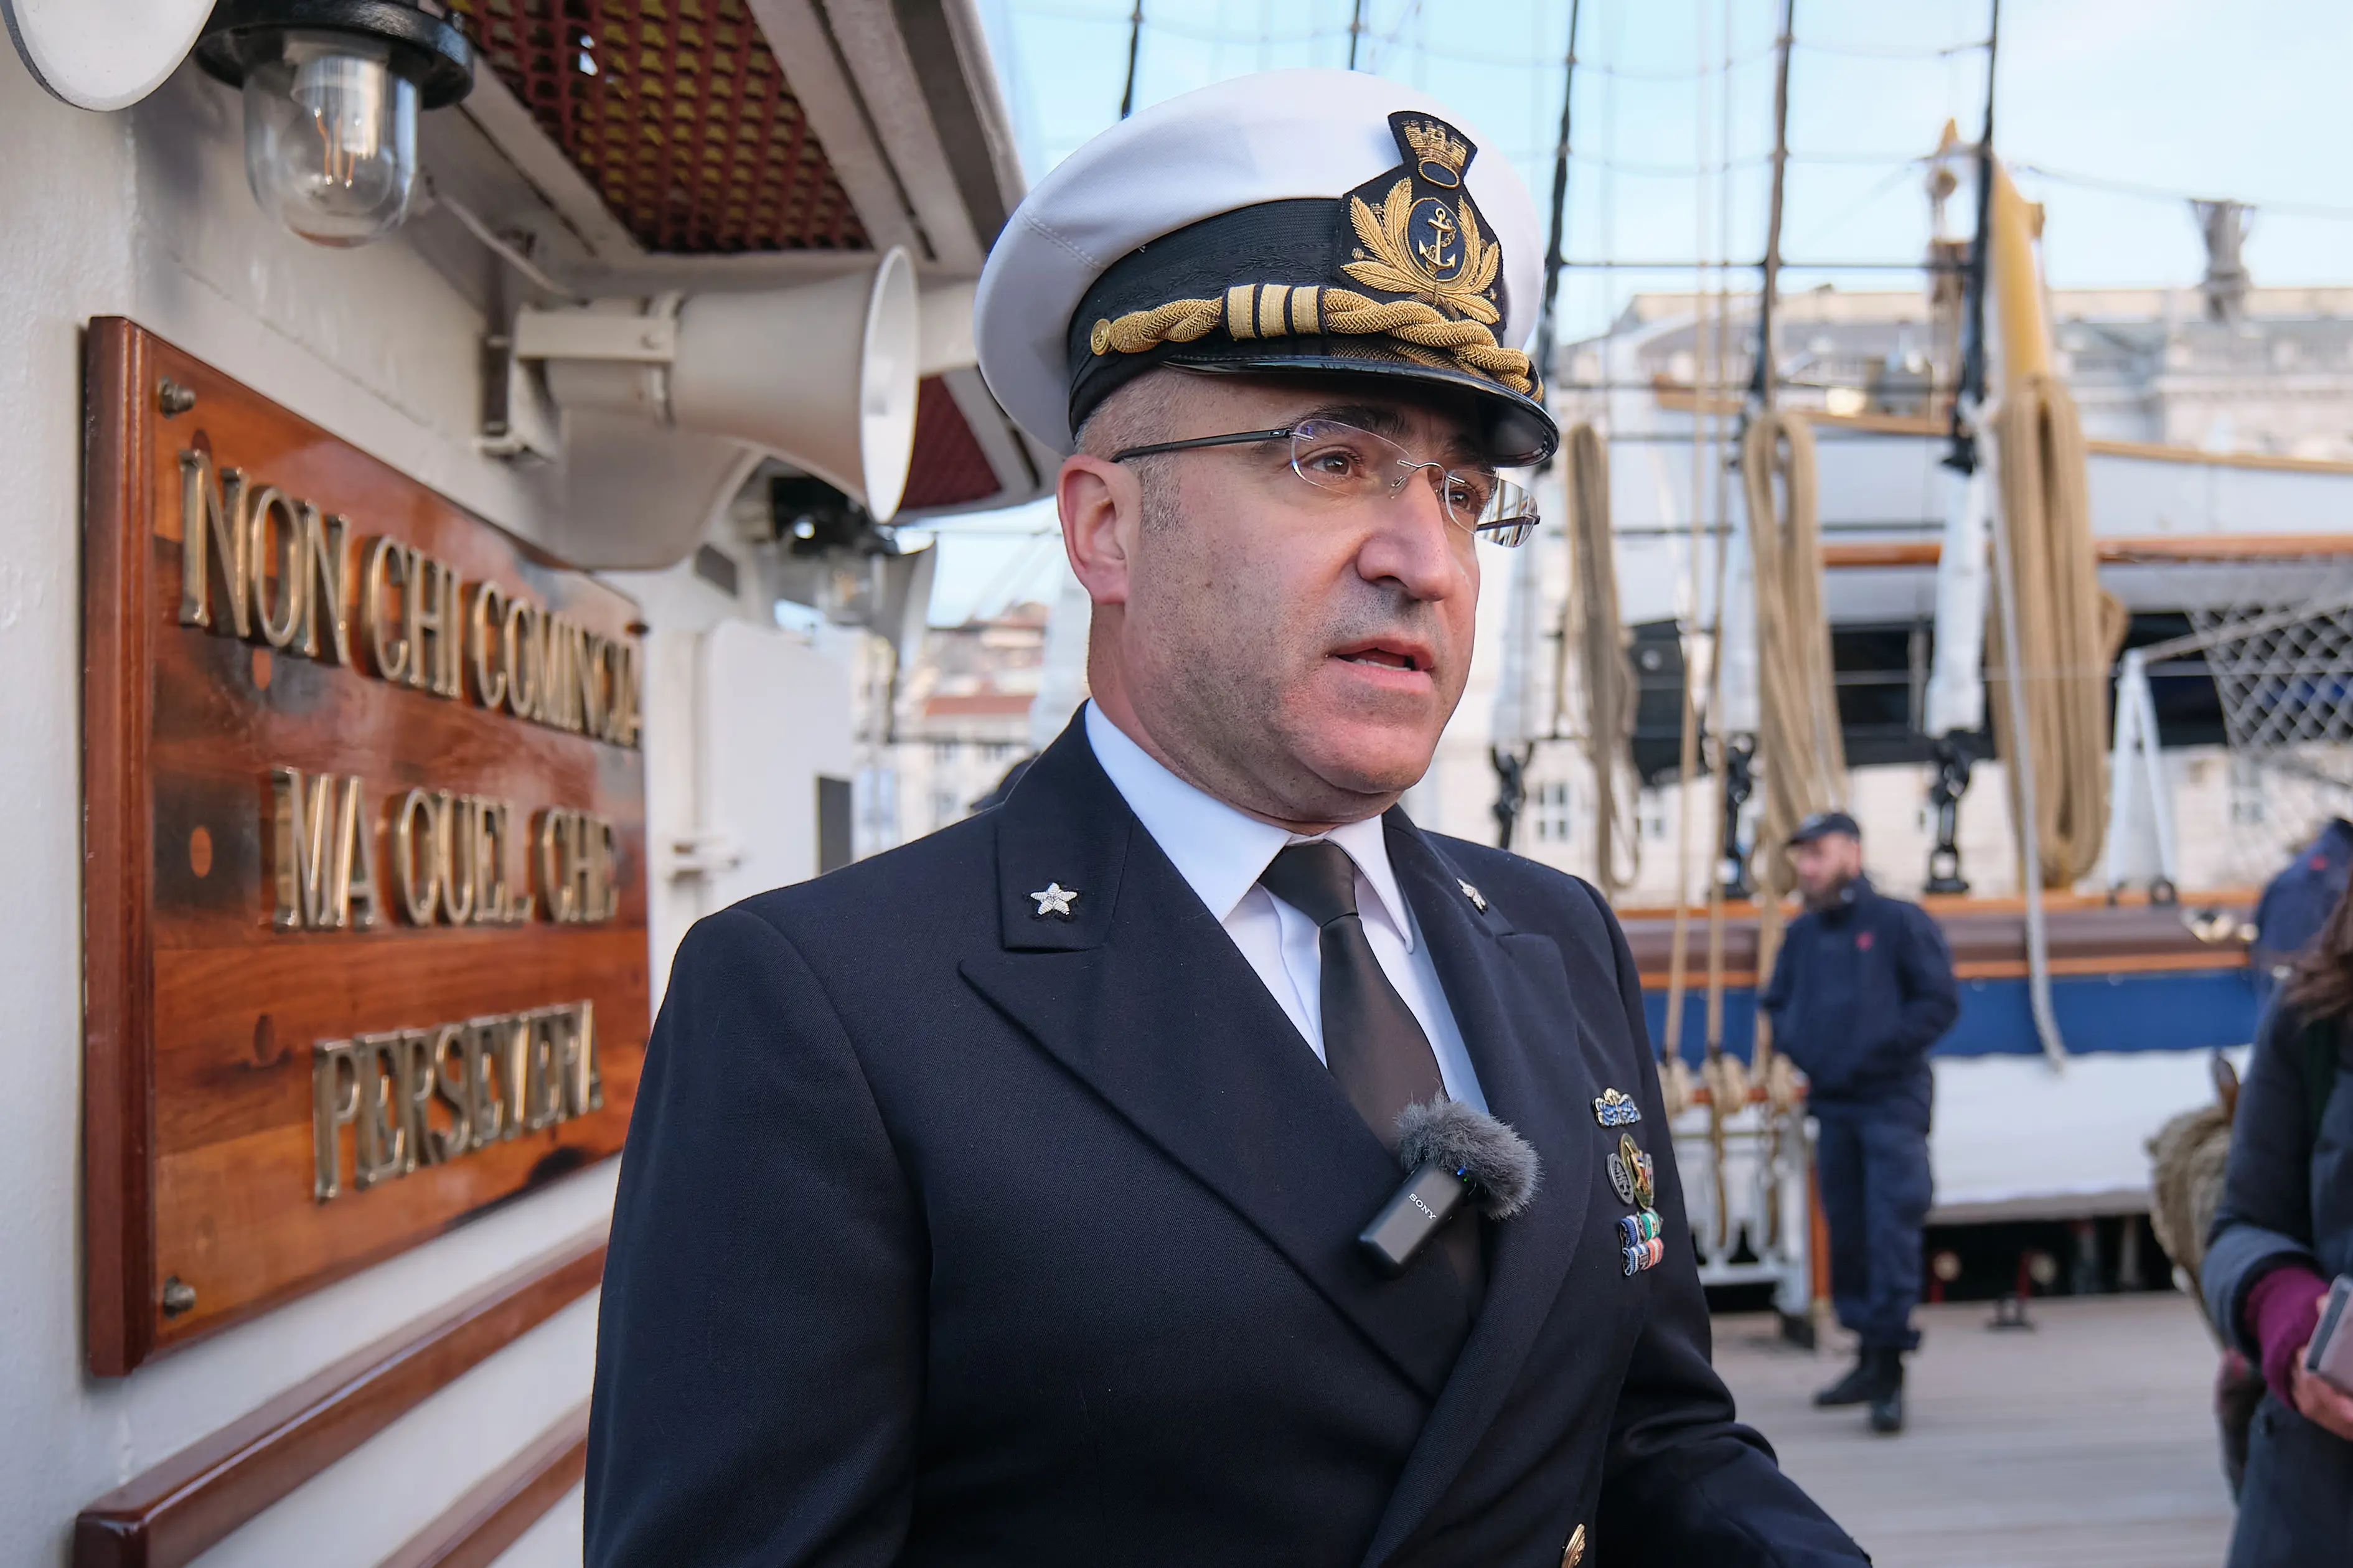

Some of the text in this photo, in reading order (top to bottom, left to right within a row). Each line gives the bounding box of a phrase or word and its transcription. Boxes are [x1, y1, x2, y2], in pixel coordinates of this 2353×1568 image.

[179, 449, 350, 666] NON
[367, 535, 462, 698] CHI
[272, 767, 618, 931] MA QUEL CHE
[313, 1000, 604, 1201] PERSEVERA
[1409, 1193, 1437, 1220] SONY
